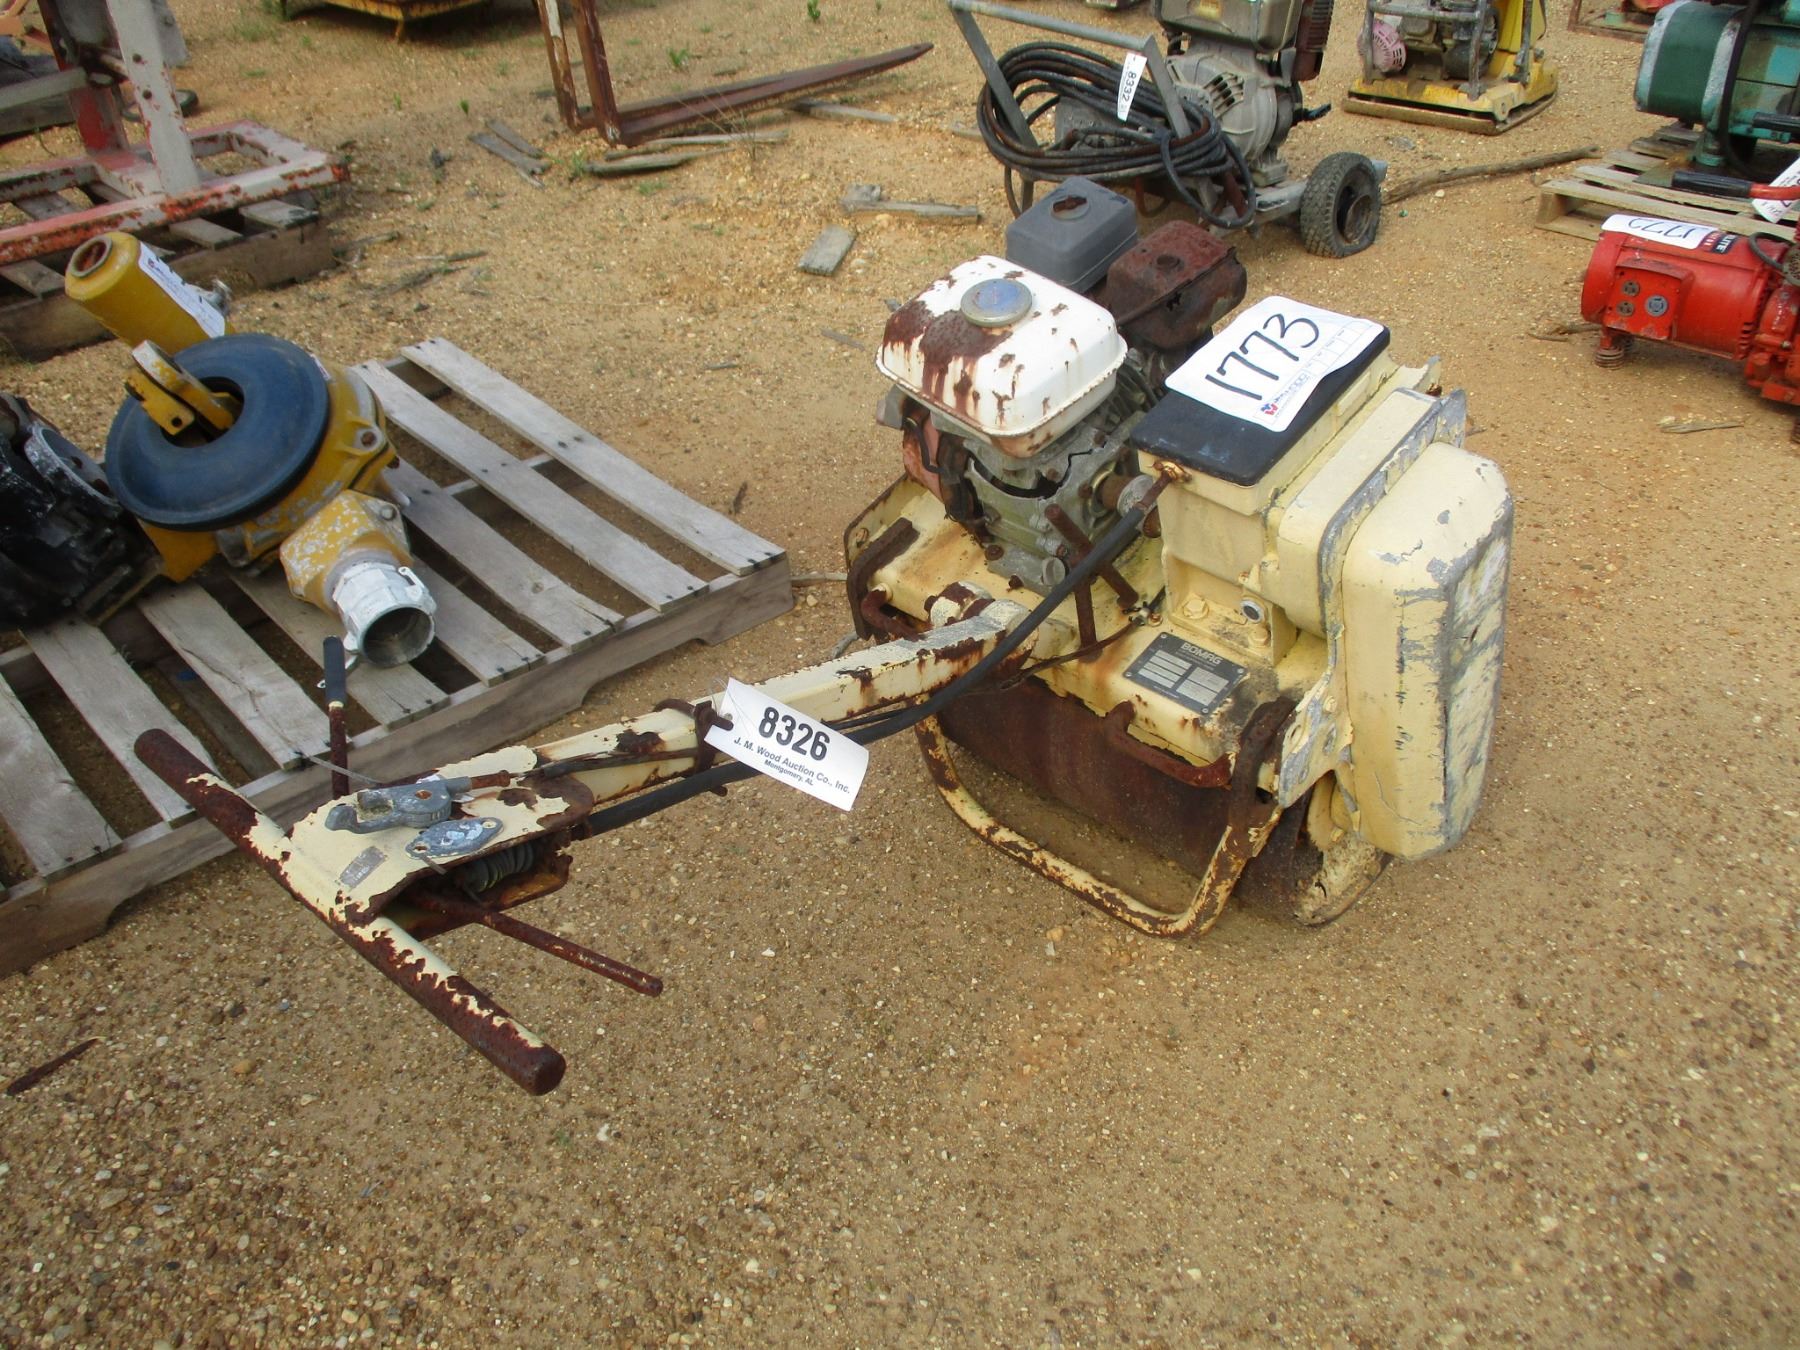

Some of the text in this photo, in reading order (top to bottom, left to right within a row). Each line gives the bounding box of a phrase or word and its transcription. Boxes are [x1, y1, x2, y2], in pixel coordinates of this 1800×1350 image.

[1121, 71, 1137, 102] 8332
[1205, 313, 1319, 400] 1773
[1181, 642, 1223, 665] BOMAG
[758, 706, 831, 761] 8326
[744, 740, 754, 751] M.
[757, 745, 782, 763] Wood
[782, 757, 815, 778] Auction
[816, 772, 833, 786] Co.,
[834, 780, 851, 794] Inc.
[764, 759, 815, 786] Montgomery, AL
